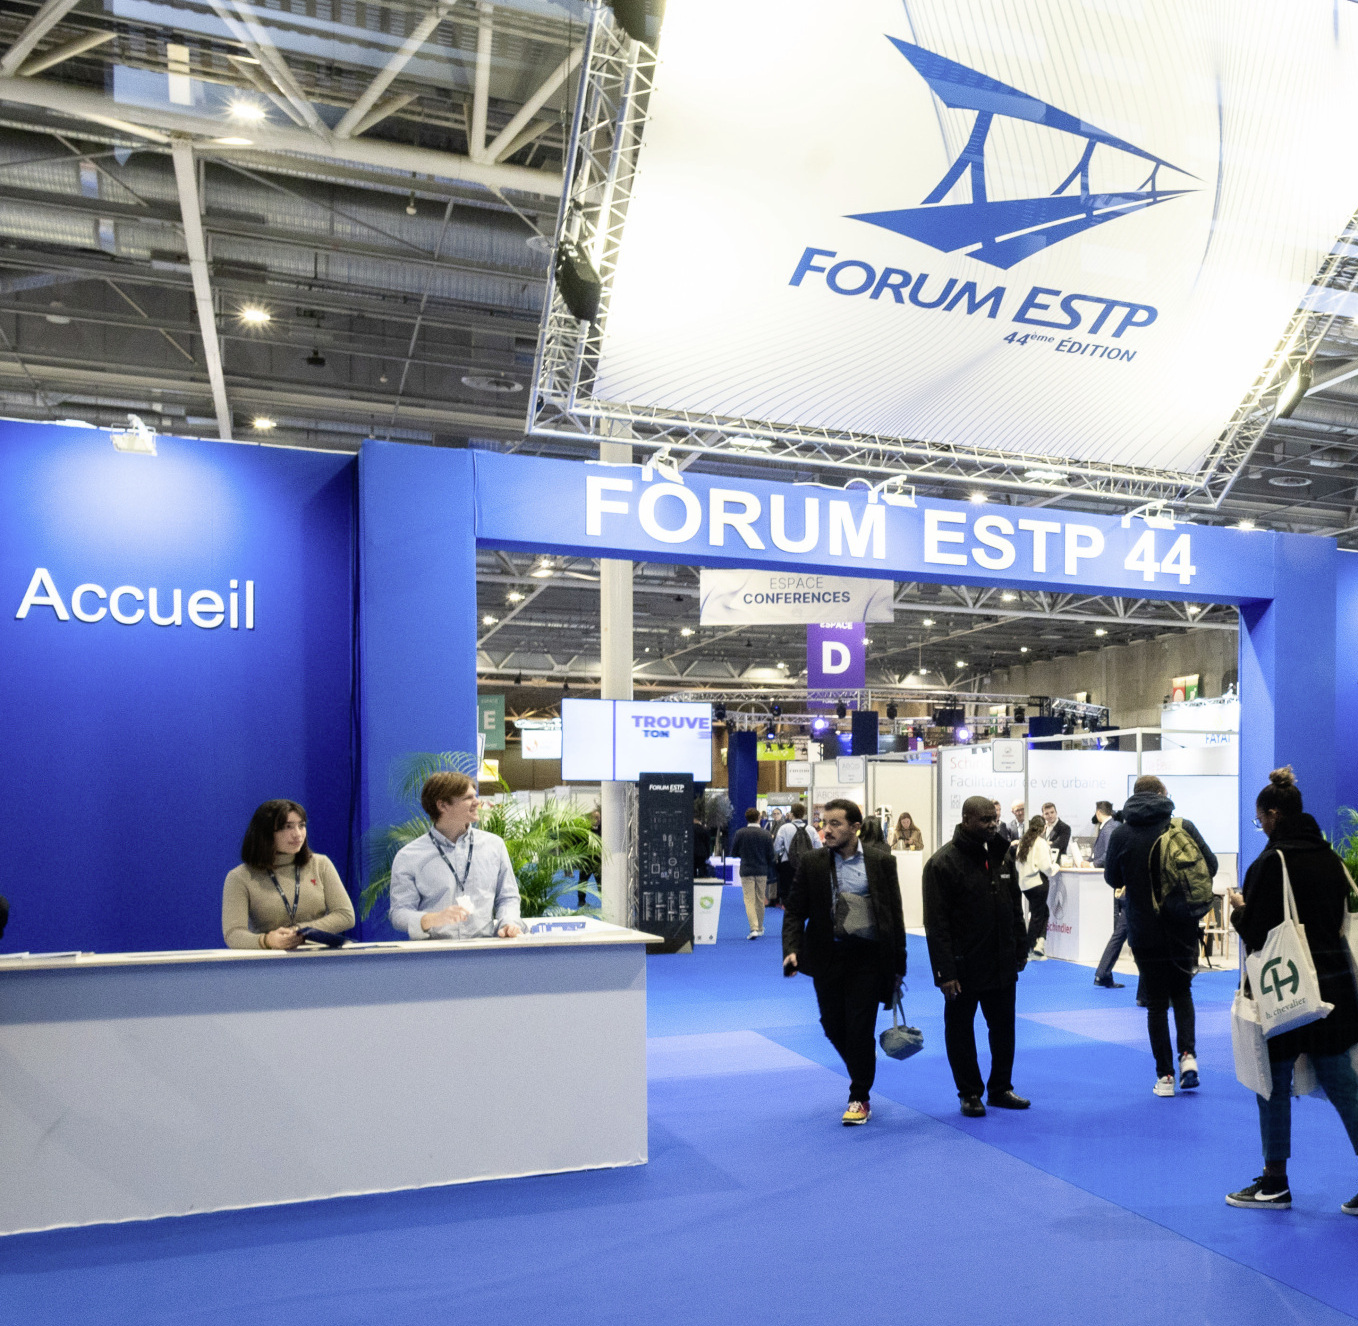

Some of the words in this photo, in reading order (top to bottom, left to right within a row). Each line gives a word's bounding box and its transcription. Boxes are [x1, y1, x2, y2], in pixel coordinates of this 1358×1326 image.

[788, 247, 1006, 319] FORUM
[1012, 286, 1158, 338] ESTP
[1003, 331, 1055, 346] 44ème
[1055, 337, 1137, 362] ÉDITION
[586, 476, 886, 559] FORUM
[924, 509, 1105, 576] ESTP
[1124, 529, 1196, 585] 44
[770, 576, 824, 589] ESPACE
[15, 568, 255, 629] Accueil
[743, 591, 851, 604] CONFERENCES
[822, 641, 851, 674] D
[484, 711, 496, 730] E
[631, 715, 710, 729] TROUVE
[642, 730, 670, 738] TON
[950, 775, 1017, 788] Facilitateur
[1041, 776, 1058, 788] vie
[1062, 776, 1107, 789] urbaine
